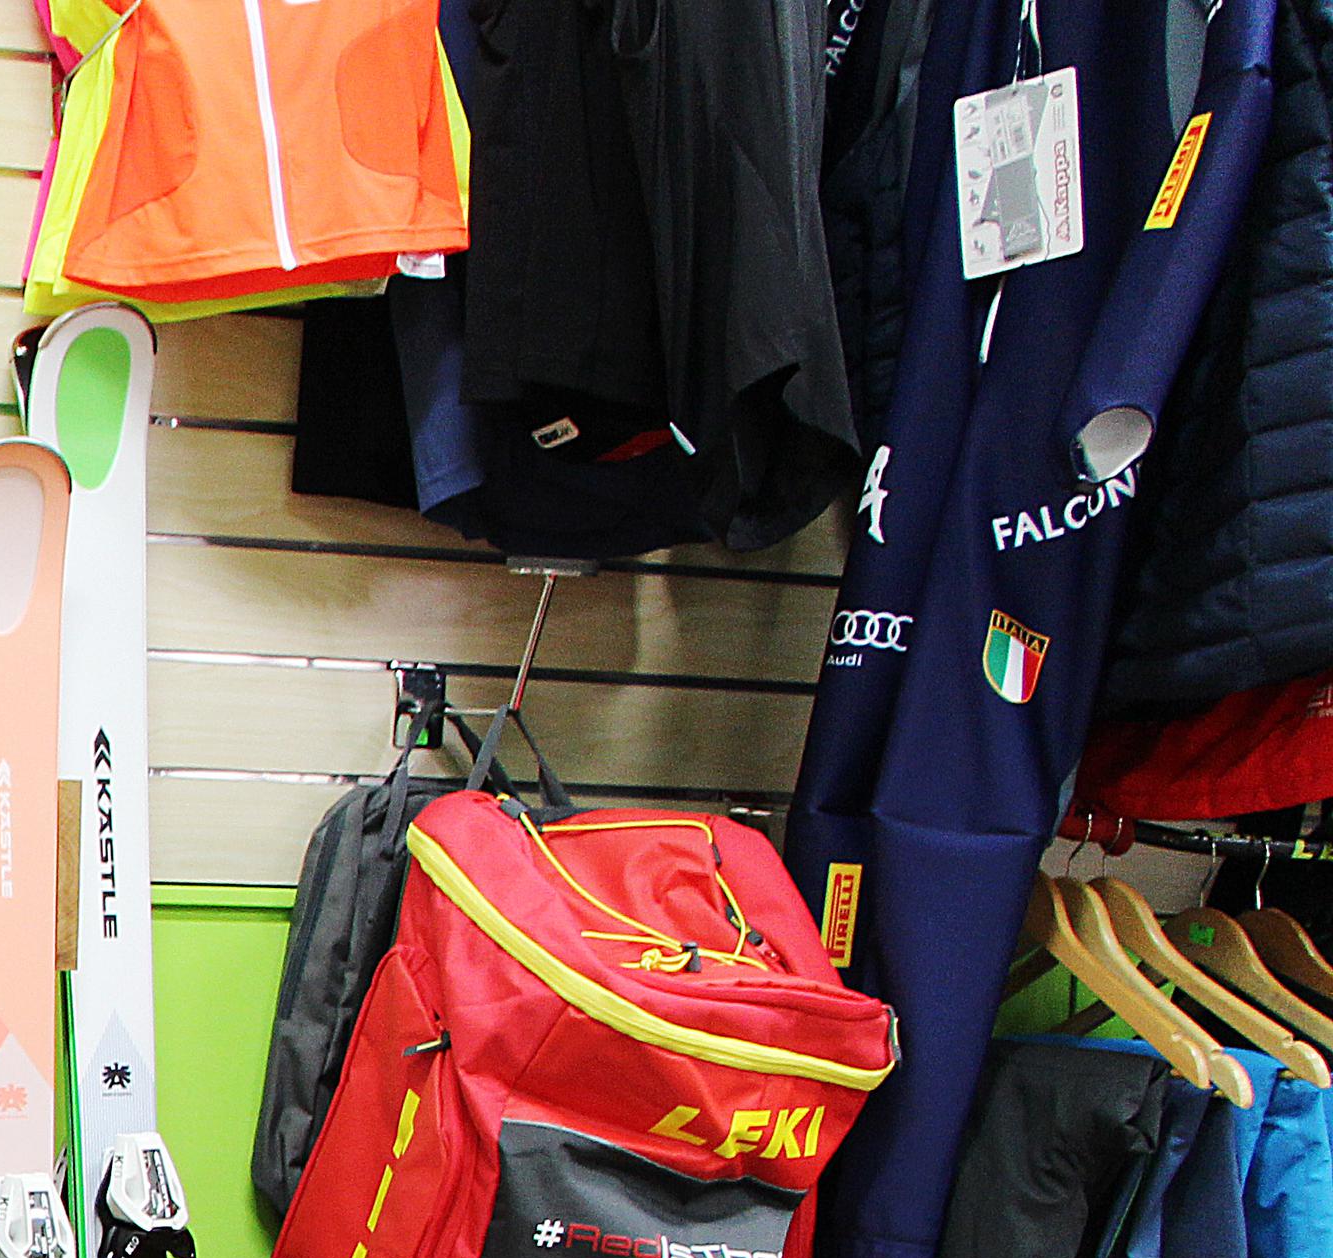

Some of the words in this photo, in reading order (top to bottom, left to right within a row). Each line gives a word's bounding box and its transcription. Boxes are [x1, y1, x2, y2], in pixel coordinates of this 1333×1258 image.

[1053, 139, 1072, 222] Kappa
[993, 613, 1046, 652] ITALIA
[832, 873, 855, 959] PIRELLI
[649, 1105, 826, 1159] LEKI
